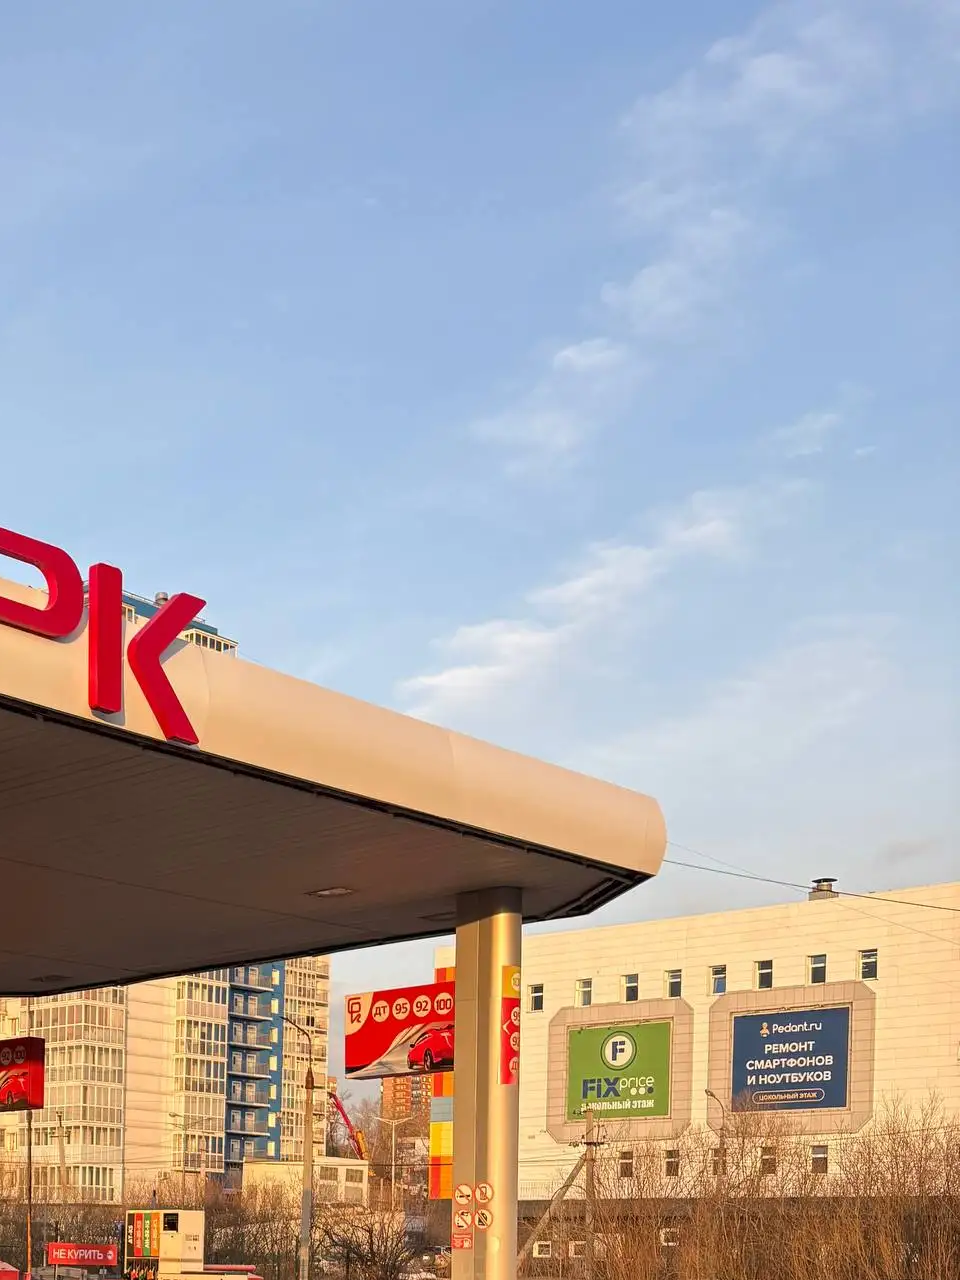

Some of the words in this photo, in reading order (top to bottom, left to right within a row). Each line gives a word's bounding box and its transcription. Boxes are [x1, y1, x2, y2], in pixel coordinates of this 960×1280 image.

[394, 1002, 409, 1015] 95
[415, 1000, 430, 1013] 92
[435, 998, 453, 1012] 100
[772, 1022, 822, 1034] Pedant.ru
[611, 1040, 626, 1062] F
[764, 1041, 816, 1054] РЕМОНТ
[745, 1055, 834, 1071] СМАРТФОНОВ
[746, 1075, 756, 1086] И
[758, 1071, 832, 1085] НОУТБУКОВ
[52, 1248, 66, 1259] НЕ
[67, 1249, 104, 1260] КУРИТЬ
